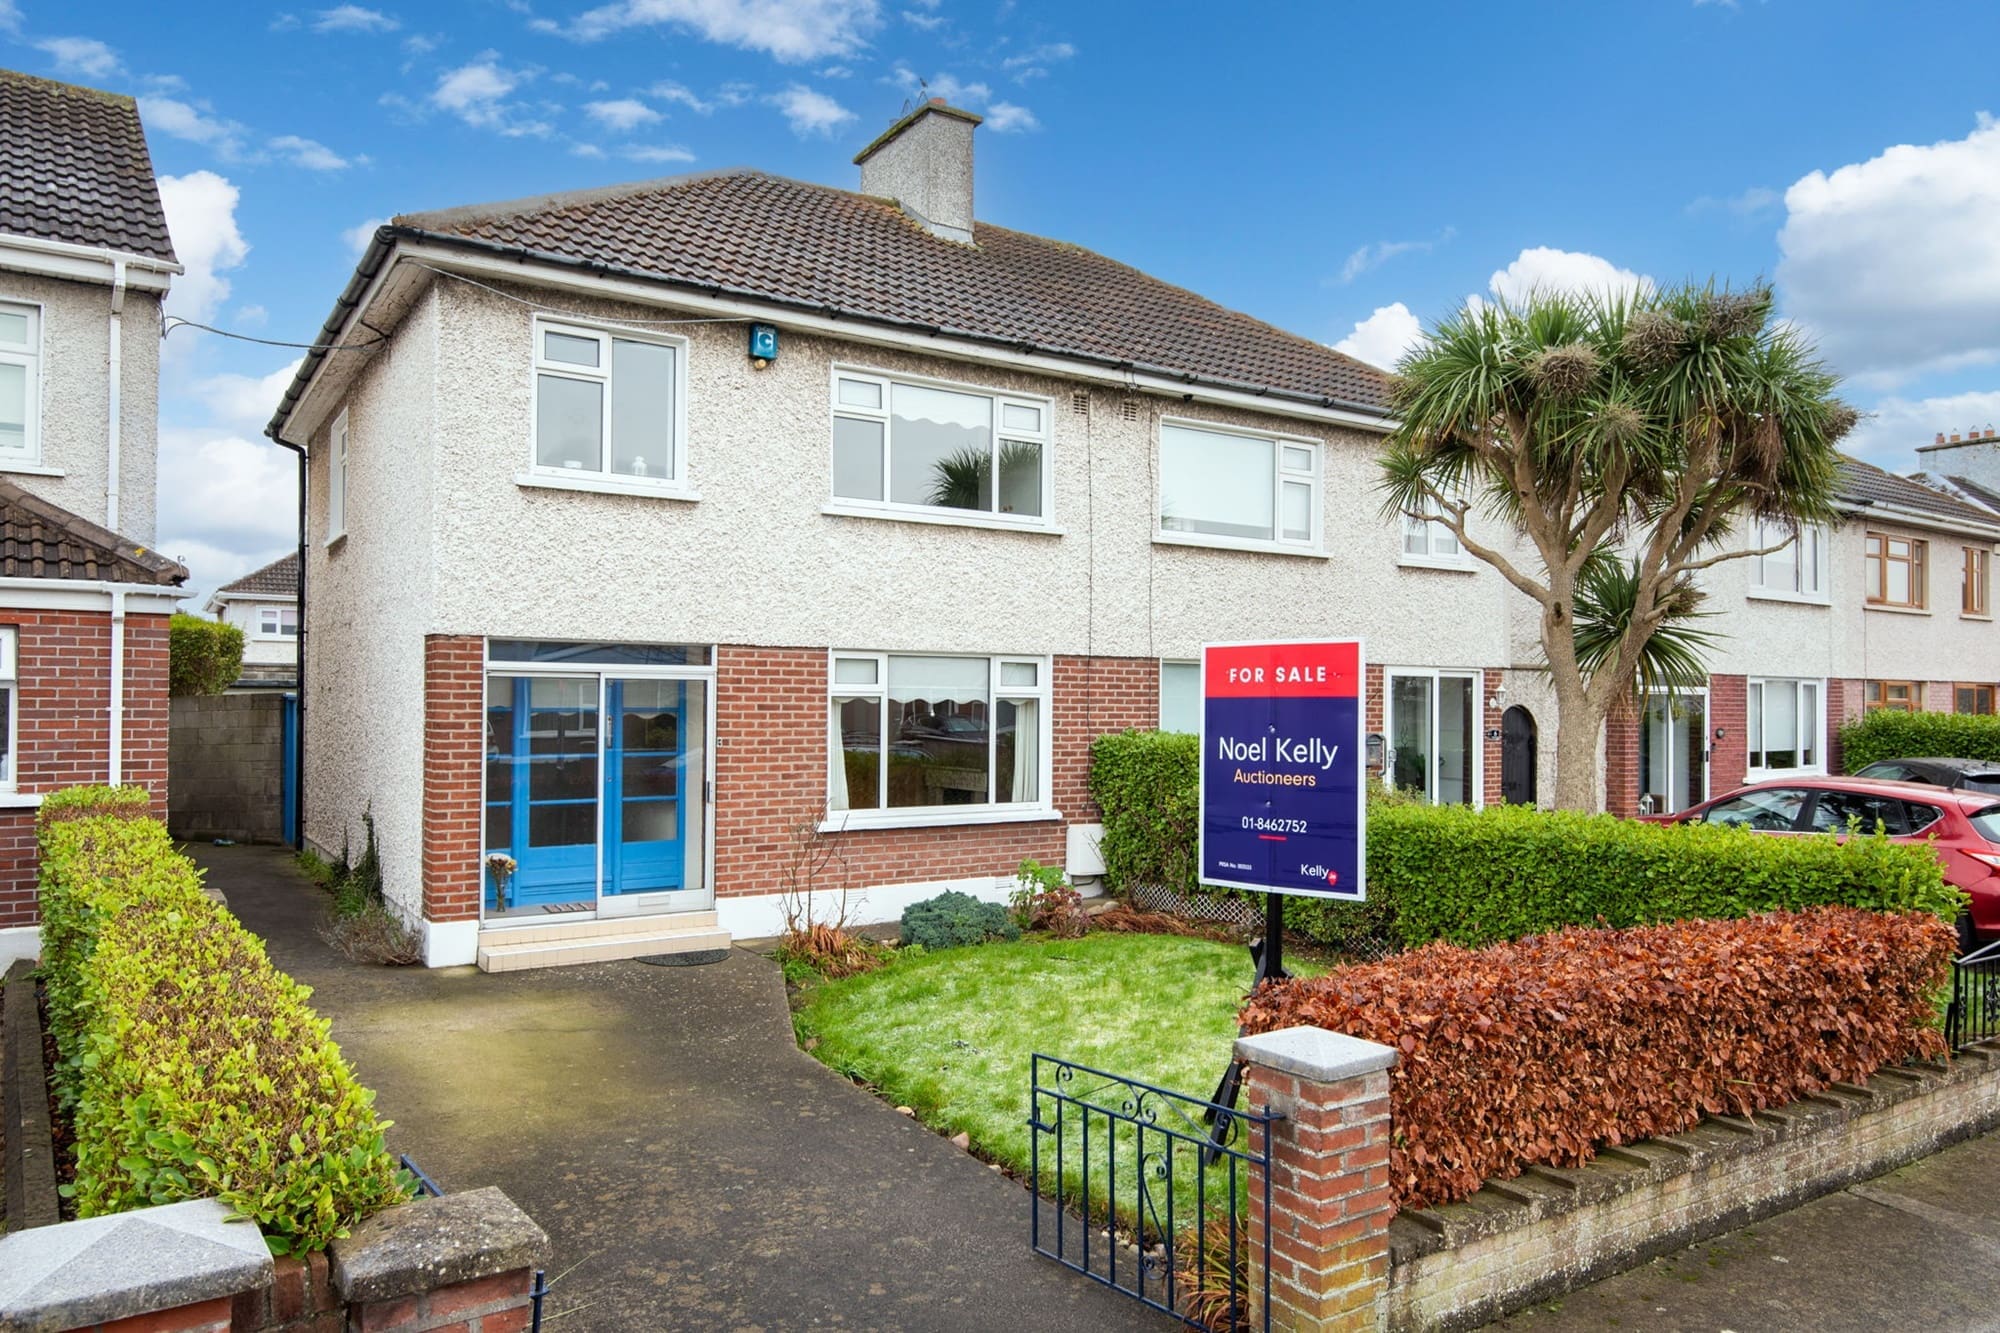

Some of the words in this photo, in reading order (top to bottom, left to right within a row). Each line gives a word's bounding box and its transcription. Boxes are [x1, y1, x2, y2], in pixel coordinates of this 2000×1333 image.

[1229, 668, 1264, 683] FOR
[1275, 666, 1326, 682] SALE
[1219, 737, 1266, 761] Noel
[1276, 738, 1338, 770] Kelly
[1233, 768, 1316, 787] Auctioneers
[1241, 816, 1307, 833] 01-8462752
[1300, 863, 1329, 880] Kelly
